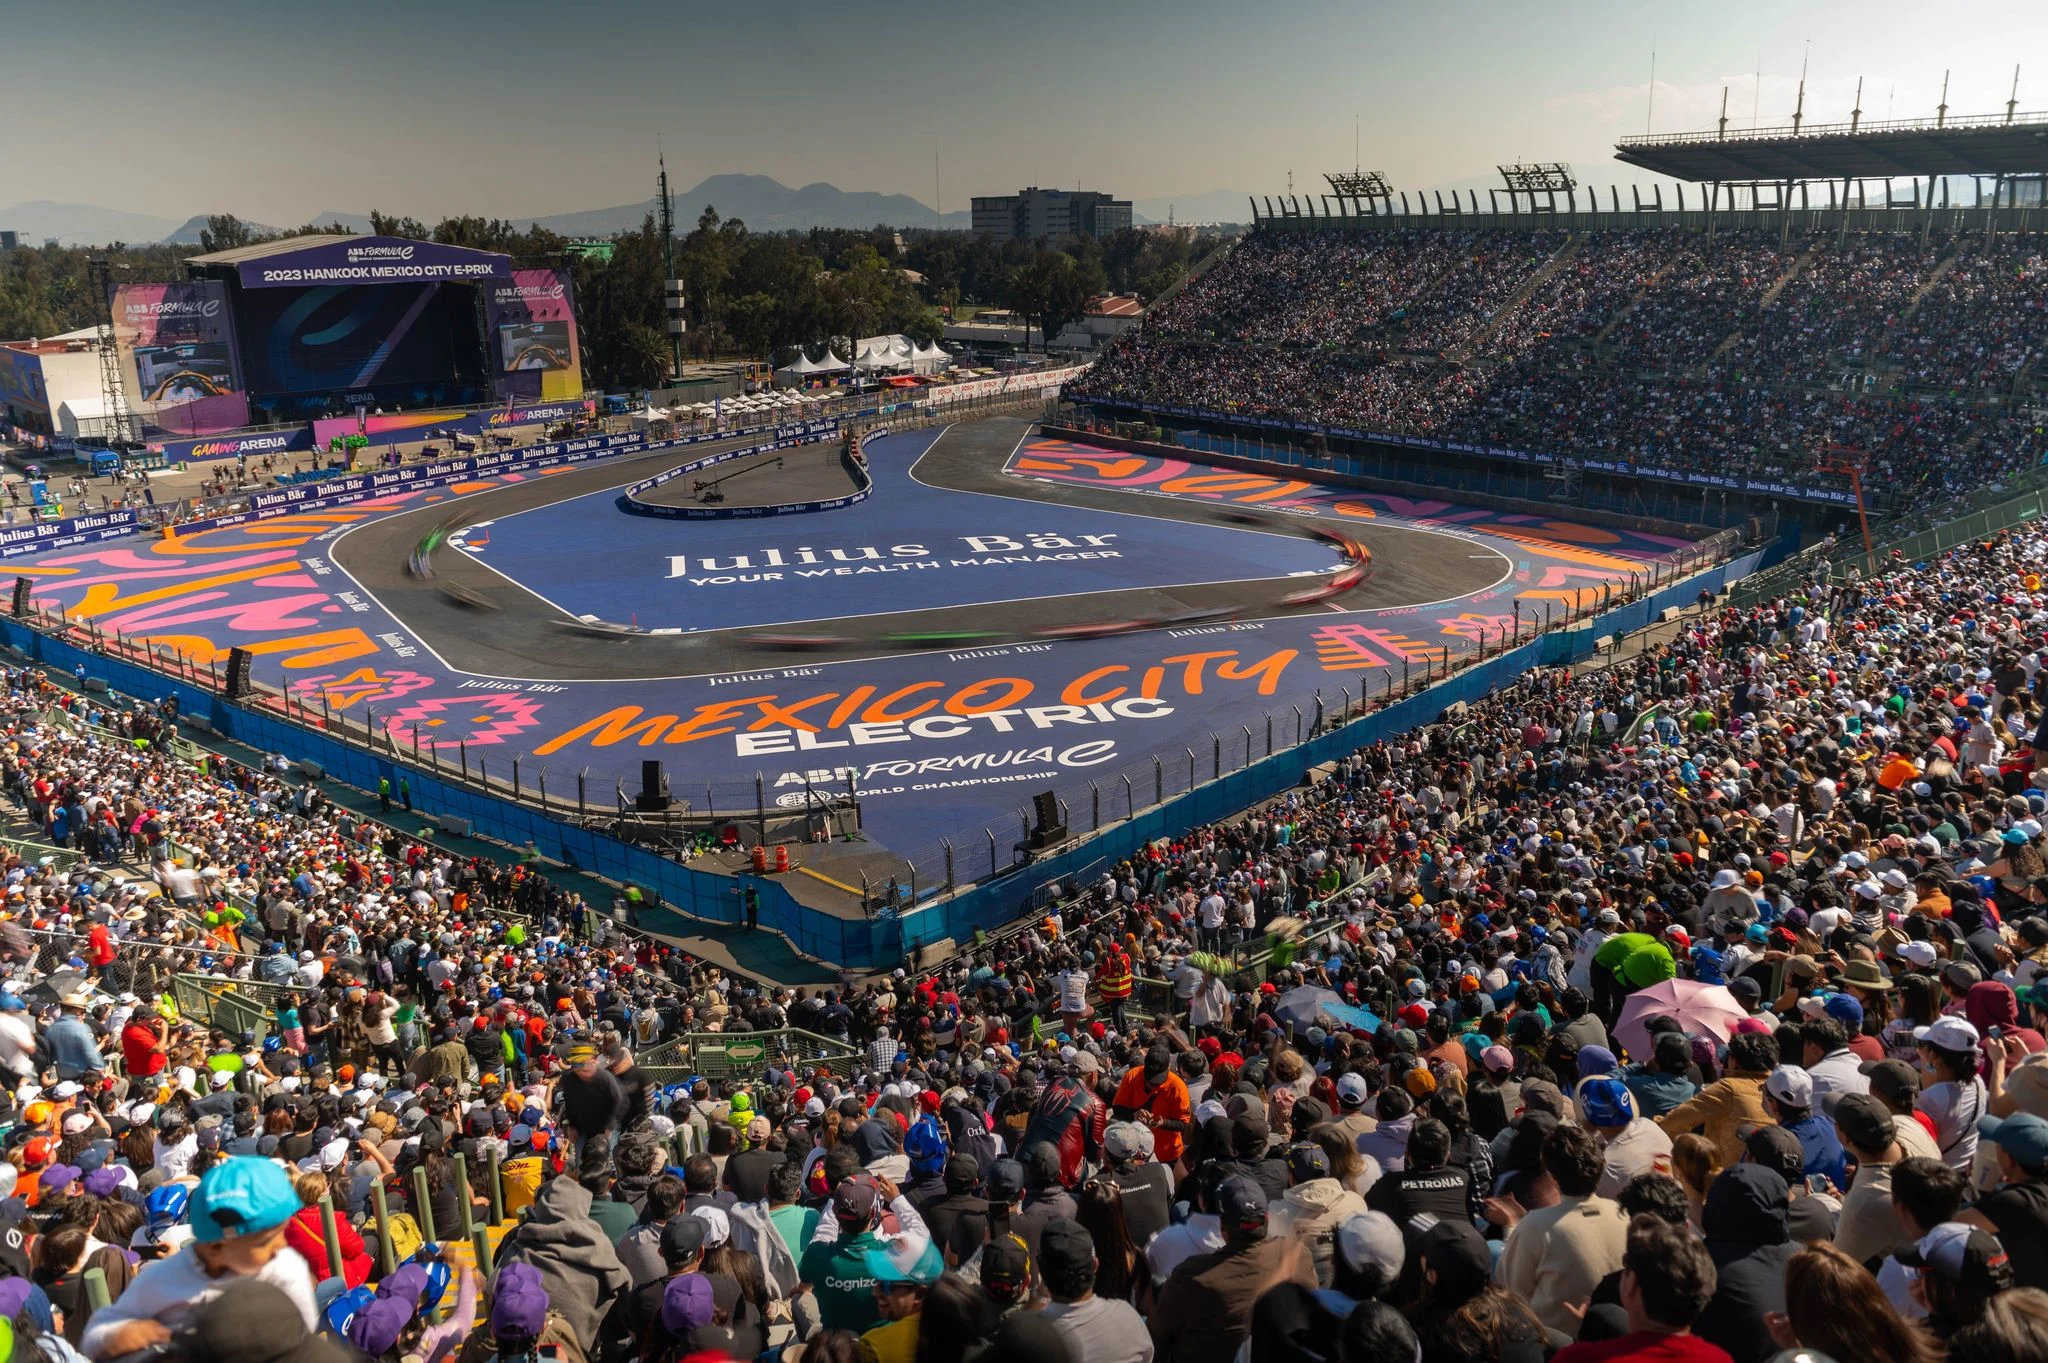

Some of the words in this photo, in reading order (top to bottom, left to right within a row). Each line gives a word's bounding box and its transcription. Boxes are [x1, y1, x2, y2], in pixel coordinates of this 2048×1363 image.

[348, 247, 364, 256] ABB
[364, 246, 401, 256] FORMULA
[264, 270, 301, 282] 2023
[303, 267, 370, 280] HANKOOK
[372, 266, 422, 278] MEXICO
[424, 265, 452, 276] CITY
[454, 264, 493, 274] E-PRIX
[495, 288, 512, 296] ABB
[512, 287, 552, 296] FORMULA
[126, 304, 148, 314] ABB
[149, 300, 201, 314] FORMULA
[528, 408, 564, 420] ARENA
[608, 436, 628, 447] Julius
[629, 433, 641, 442] Bär
[778, 429, 794, 439] Julus
[192, 442, 240, 457] GAMING
[240, 437, 286, 451] ARENA
[522, 448, 544, 460] Julius
[545, 445, 559, 454] Bär
[566, 441, 587, 452] Julius
[588, 438, 601, 447] Bär
[476, 456, 498, 468] Julius
[500, 452, 514, 462] Bär
[426, 464, 450, 477] Julius
[452, 460, 467, 470] Bär
[1636, 467, 1656, 476] Julius
[1657, 469, 1669, 477] Bär
[374, 474, 399, 486] Julius
[400, 470, 416, 480] Bär
[1688, 473, 1708, 484] Julius
[1710, 475, 1724, 485] Bär
[317, 484, 345, 497] Julius
[347, 479, 364, 490] Bär
[1747, 481, 1768, 492] Julius
[1770, 482, 1784, 493] Bär
[256, 494, 286, 507] Julius
[288, 489, 306, 500] Bär
[1806, 489, 1828, 499] Julius
[1829, 490, 1845, 501] Bär
[74, 516, 107, 532] Julius
[110, 512, 130, 524] Bär
[216, 518, 233, 526] Julius
[0, 528, 35, 544] Julius
[38, 524, 60, 537] Bär
[101, 530, 119, 538] Julius
[3, 548, 23, 556] Julius
[25, 544, 37, 552] Bär
[54, 538, 72, 547] Julius
[664, 542, 931, 578] Julius
[957, 532, 1118, 553] Bär
[688, 572, 784, 587] YOUR
[793, 560, 940, 578] WEALTH
[950, 551, 1124, 566] MANAGER
[1167, 625, 1224, 640] Julius
[1231, 622, 1266, 633] Bär
[947, 648, 1010, 662] Julius
[1016, 642, 1054, 654] Bär
[709, 670, 776, 686] Julius
[783, 666, 823, 678] Bär
[456, 680, 522, 690] Julius
[526, 684, 568, 692] Bär
[532, 678, 1035, 756] MEXICO
[1061, 650, 1298, 706] CITY
[735, 698, 1175, 757] ELECTRIC
[774, 766, 860, 787] ABB
[864, 746, 1054, 780] FORMULA
[834, 786, 904, 799] WORLD
[912, 771, 1058, 790] CHAMPIONSHIP
[1402, 1176, 1464, 1189] PETRONAS
